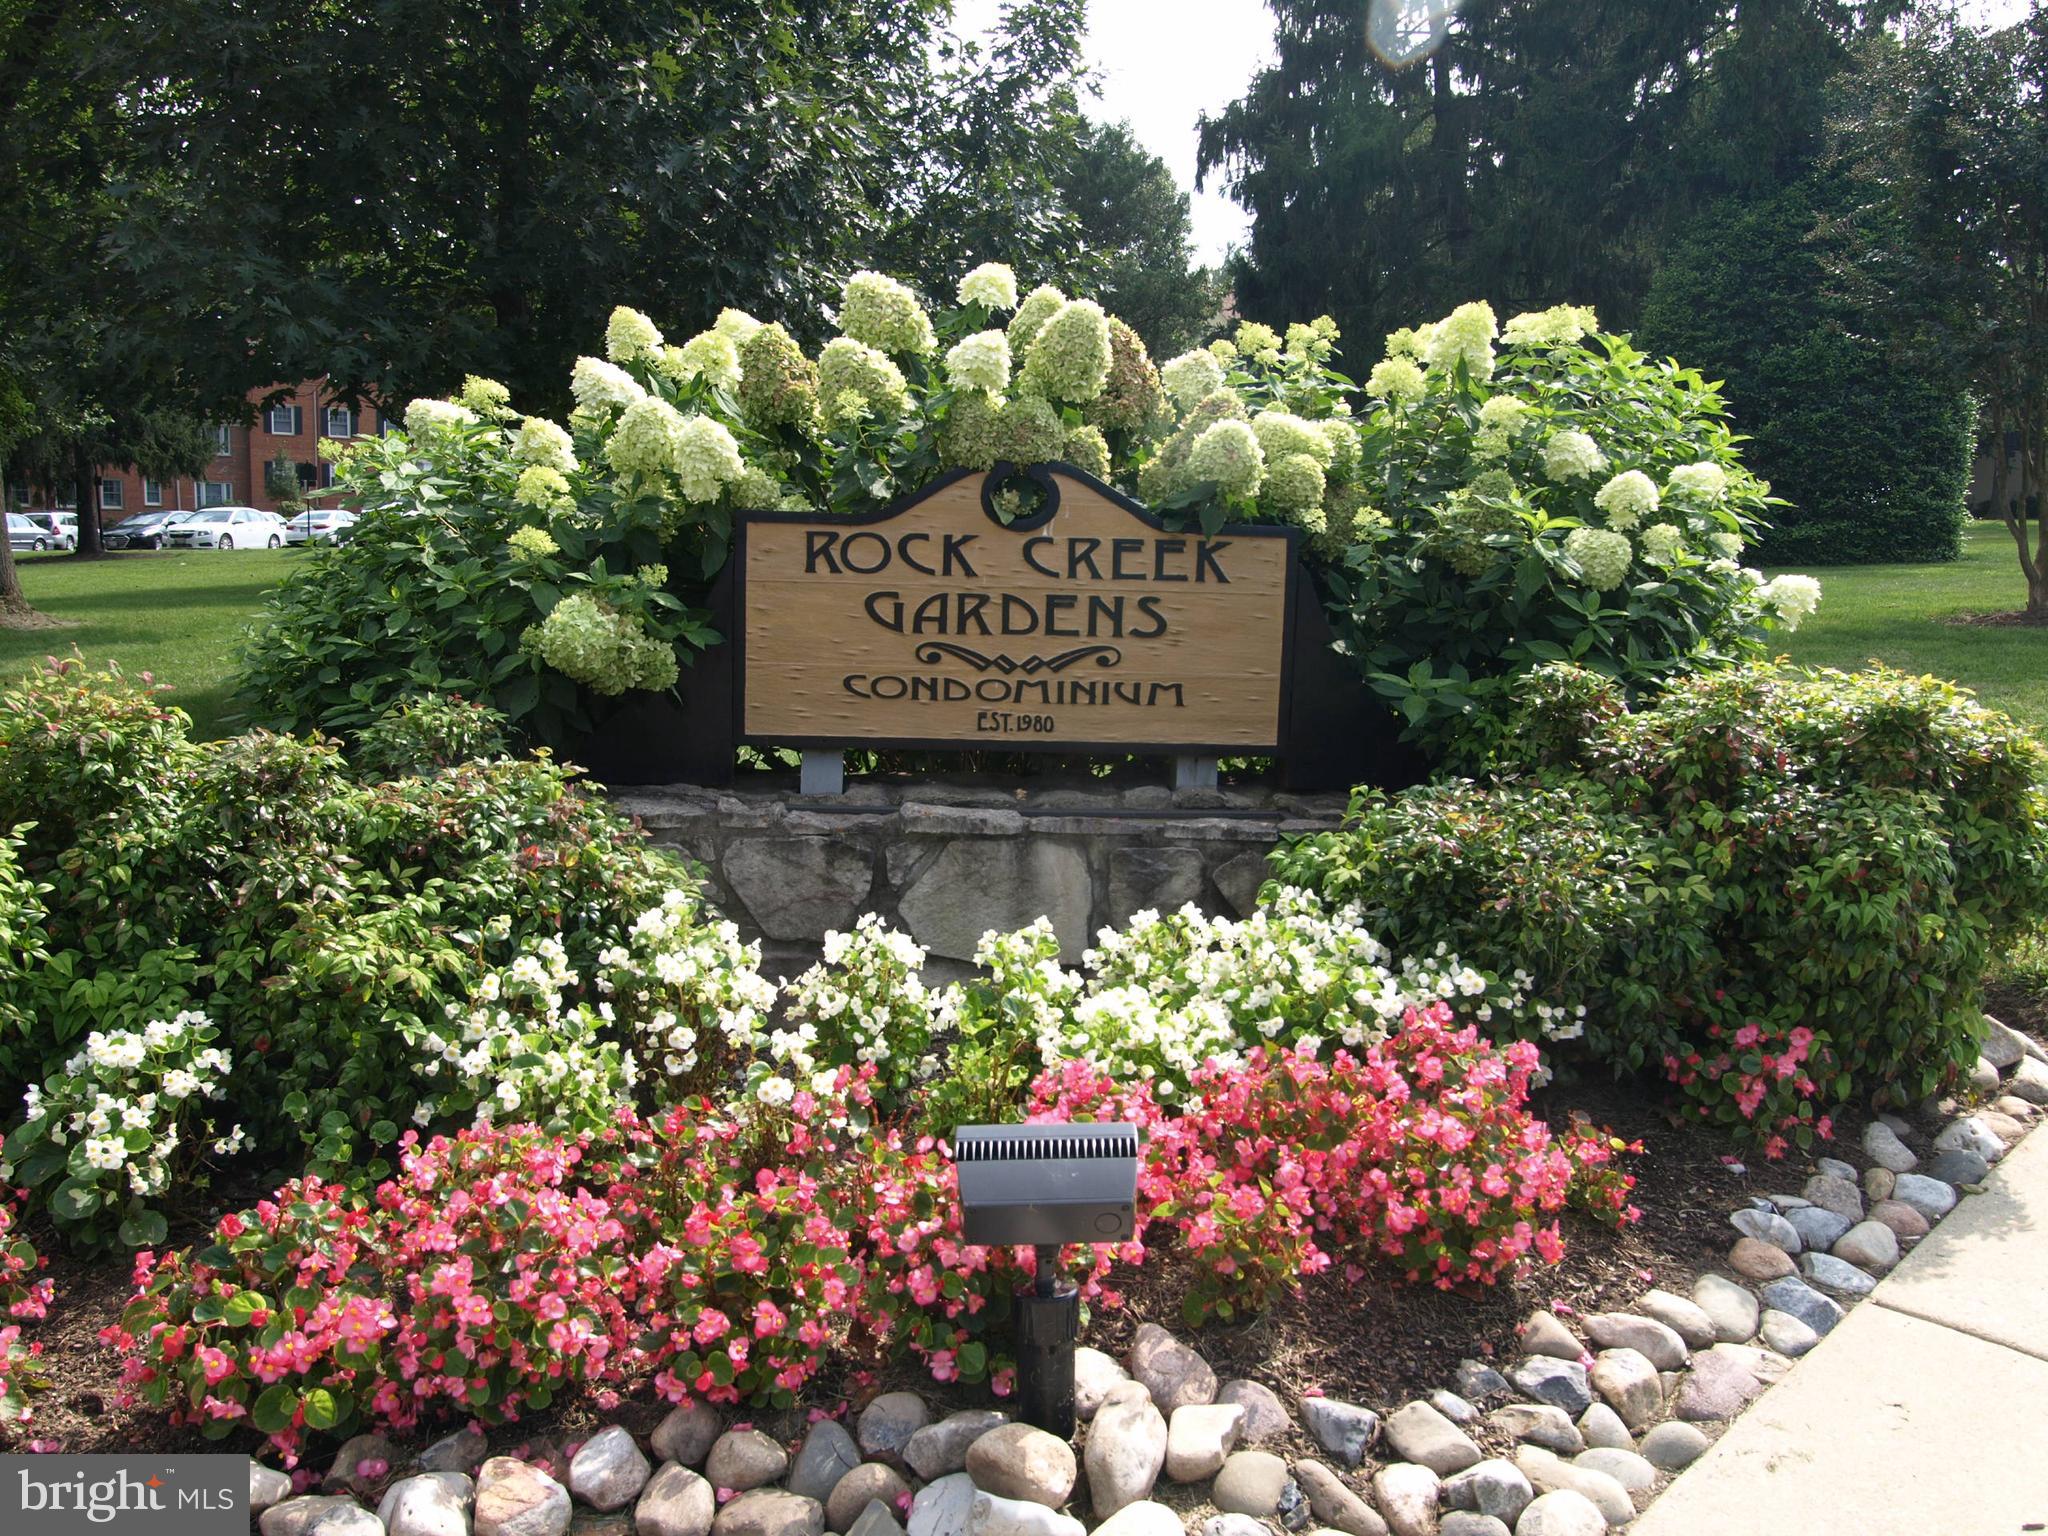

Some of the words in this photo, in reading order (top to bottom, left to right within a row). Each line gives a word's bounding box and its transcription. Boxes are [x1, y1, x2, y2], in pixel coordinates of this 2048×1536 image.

[804, 530, 979, 577] ROCK
[1022, 536, 1232, 583] CREEK
[864, 591, 1168, 638] GARDENS
[842, 674, 1185, 706] CONDOMINIUM
